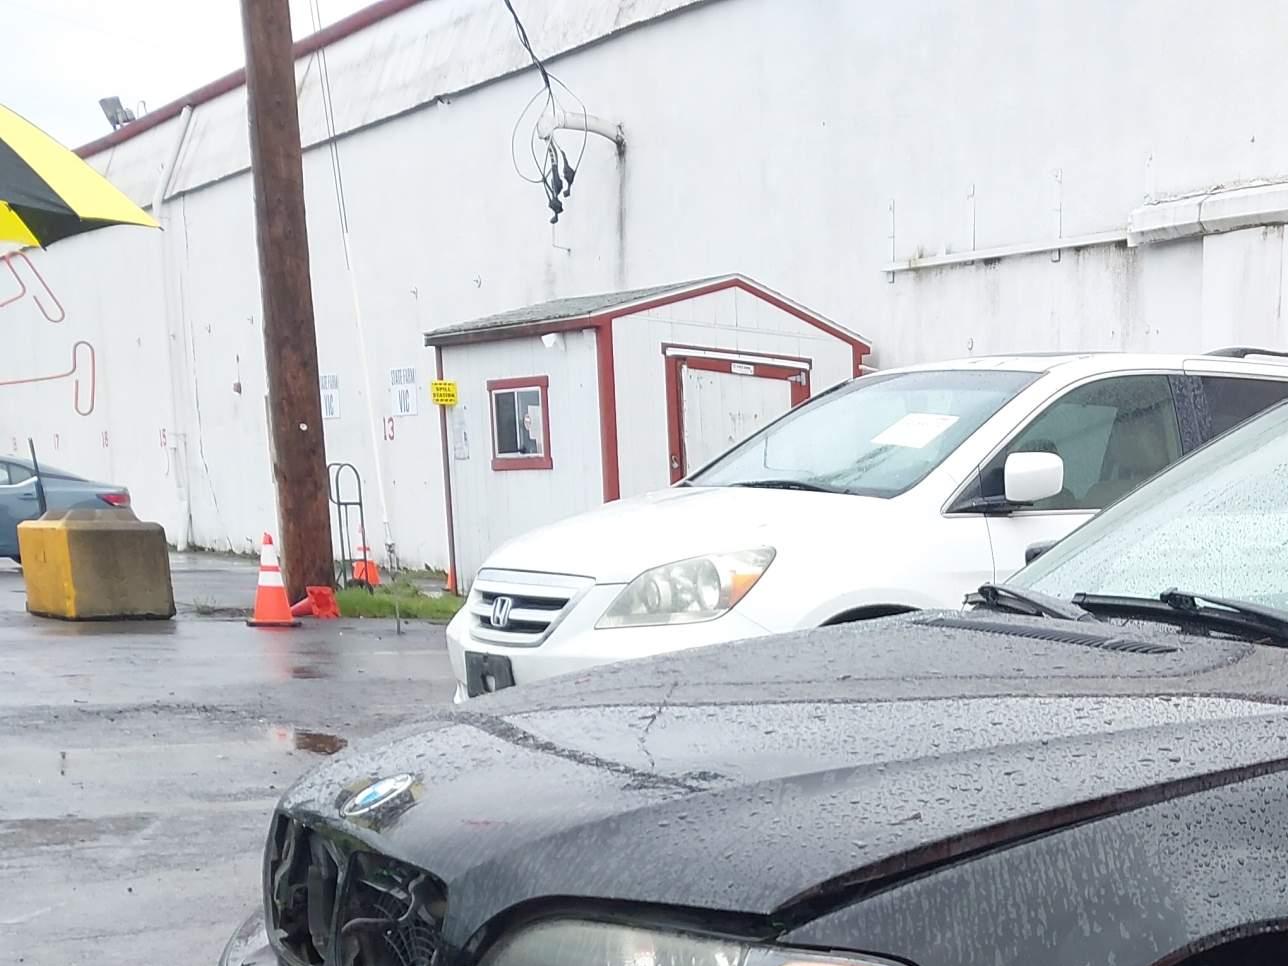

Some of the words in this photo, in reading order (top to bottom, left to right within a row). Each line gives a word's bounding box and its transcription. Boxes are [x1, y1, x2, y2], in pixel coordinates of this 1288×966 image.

[402, 367, 415, 384] FARM
[399, 389, 410, 413] VIC
[383, 416, 395, 440] 13
